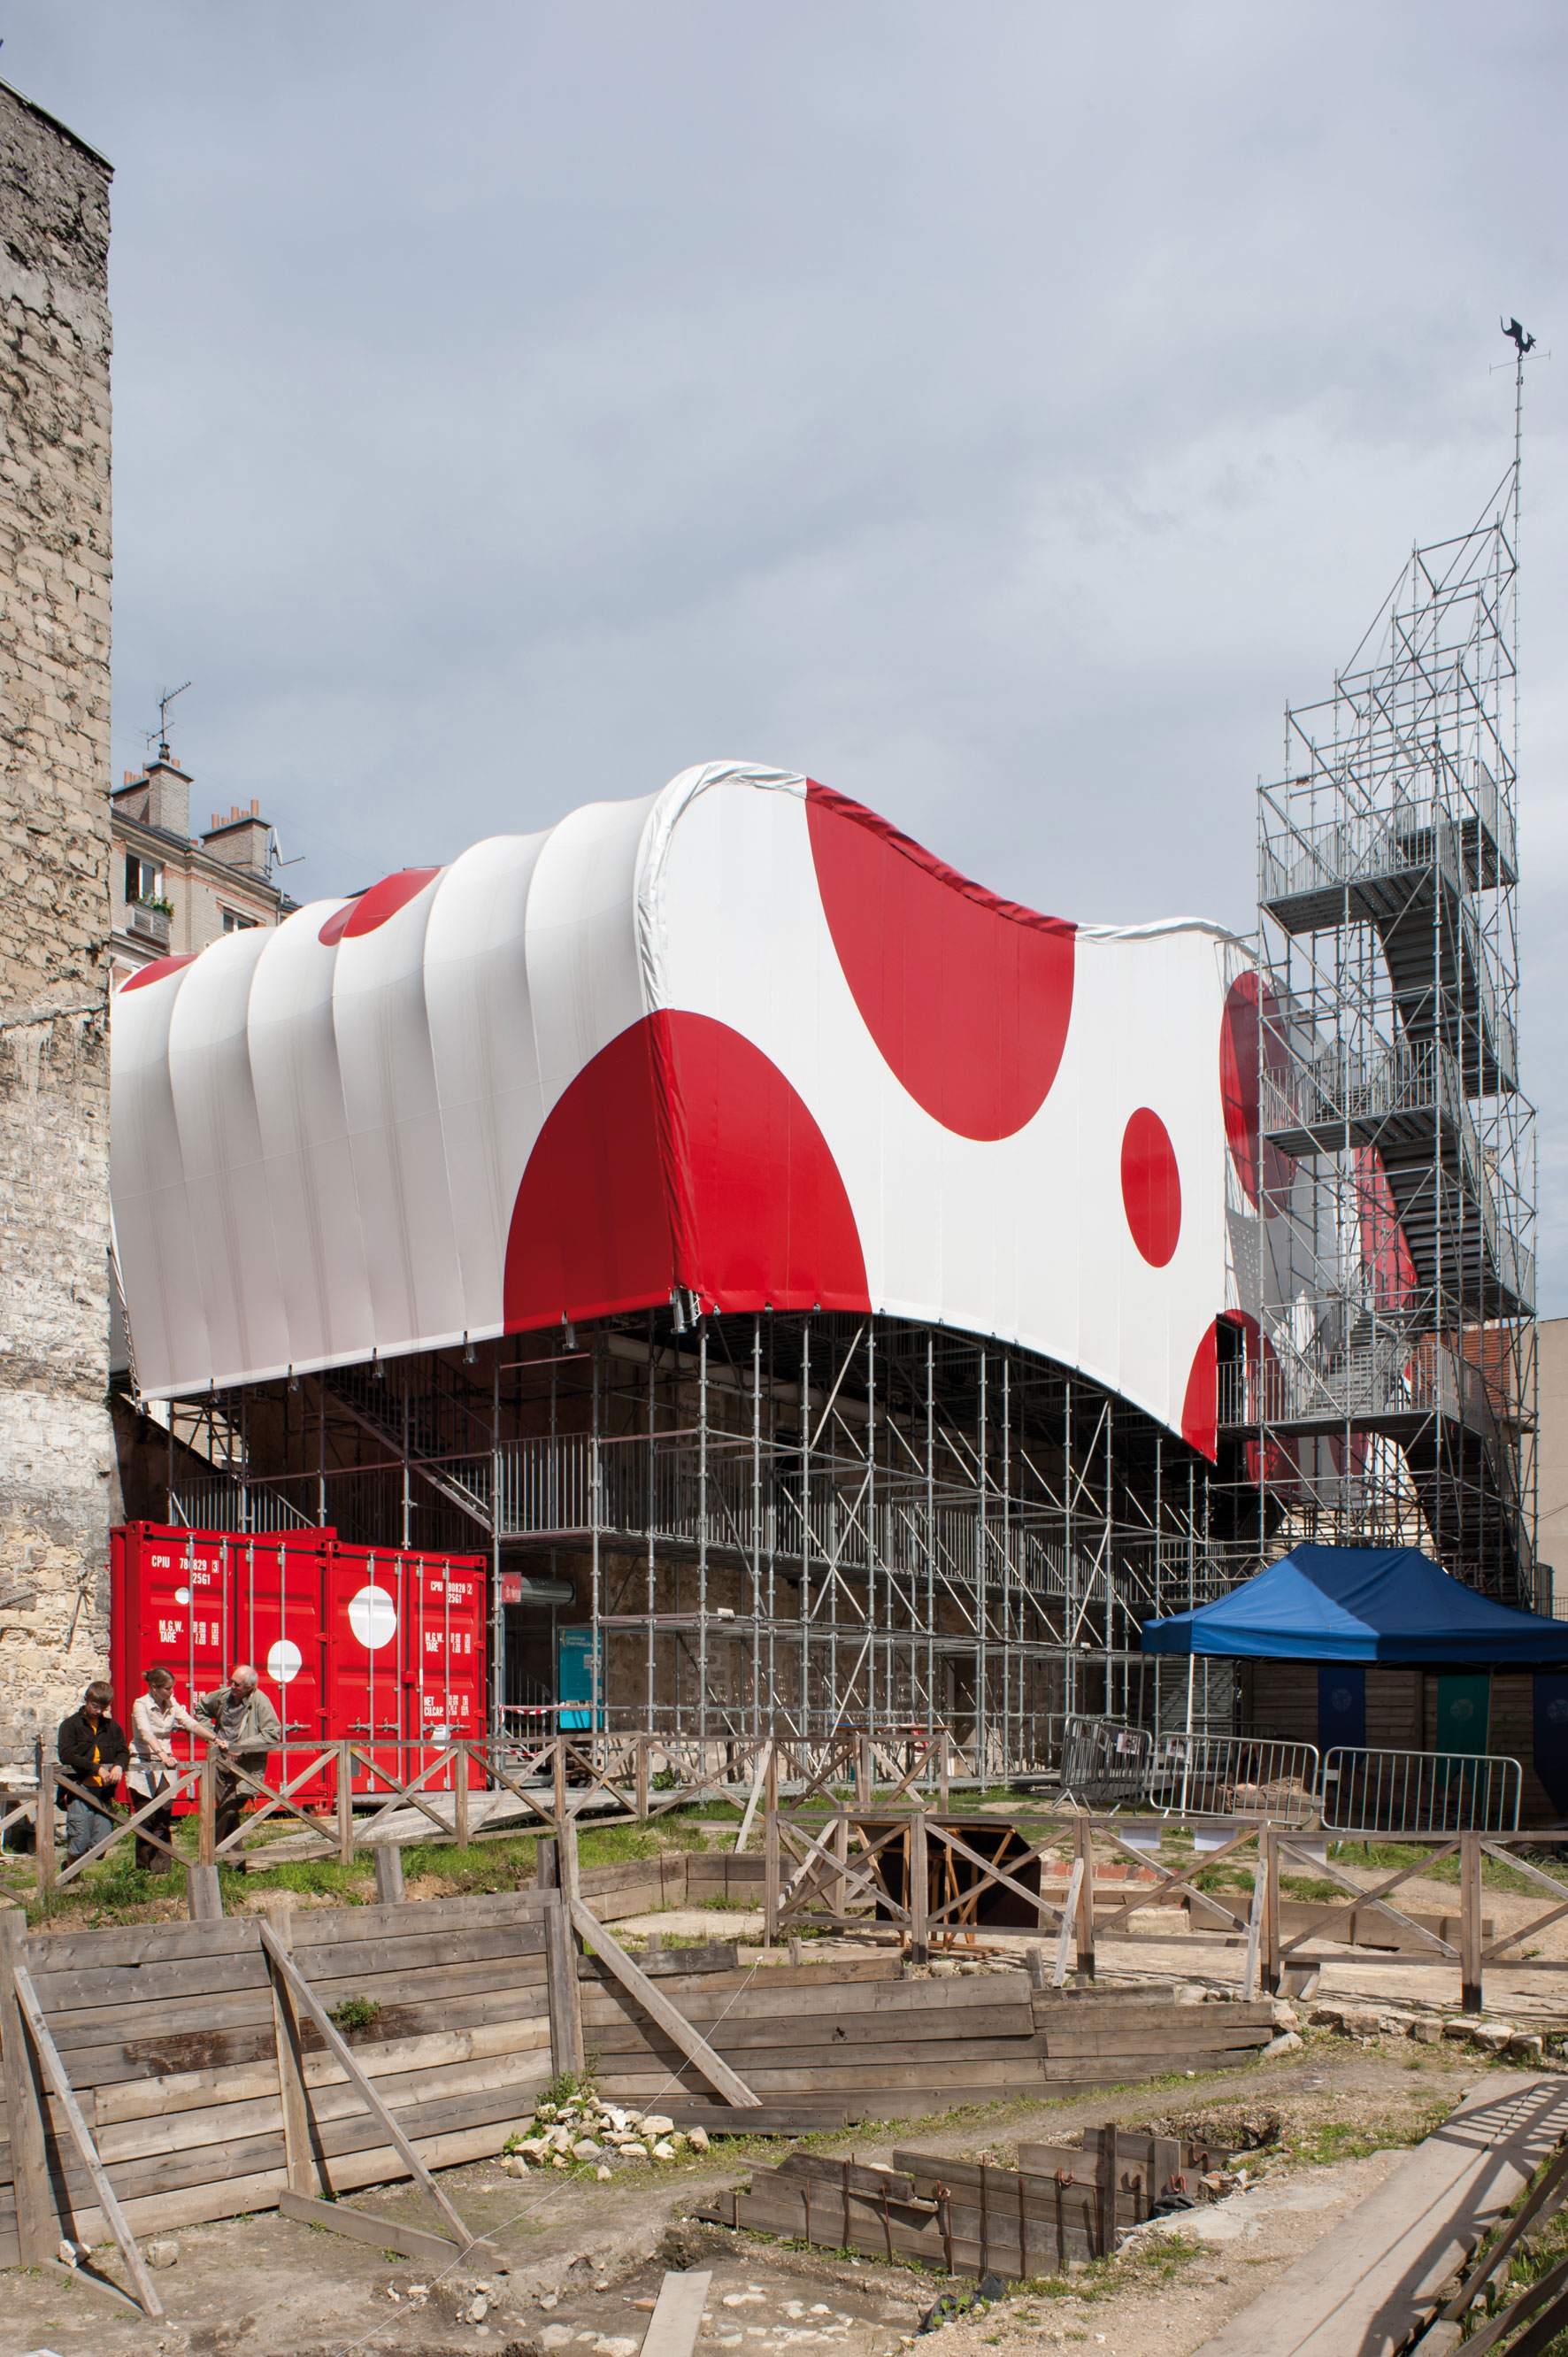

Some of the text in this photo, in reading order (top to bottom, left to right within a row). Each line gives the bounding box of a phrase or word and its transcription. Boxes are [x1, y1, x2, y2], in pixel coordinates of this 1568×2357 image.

[151, 1555, 170, 1568] CPIU
[180, 1558, 207, 1571] 78829
[192, 1573, 211, 1585] 25G1
[431, 1581, 443, 1592] CPIU
[449, 1593, 462, 1604] 25G1
[159, 1620, 184, 1632] M.G.W.
[160, 1631, 177, 1643] TARE
[426, 1632, 444, 1643] M.G.W.
[426, 1642, 439, 1652] TARE
[424, 1696, 434, 1706] NET
